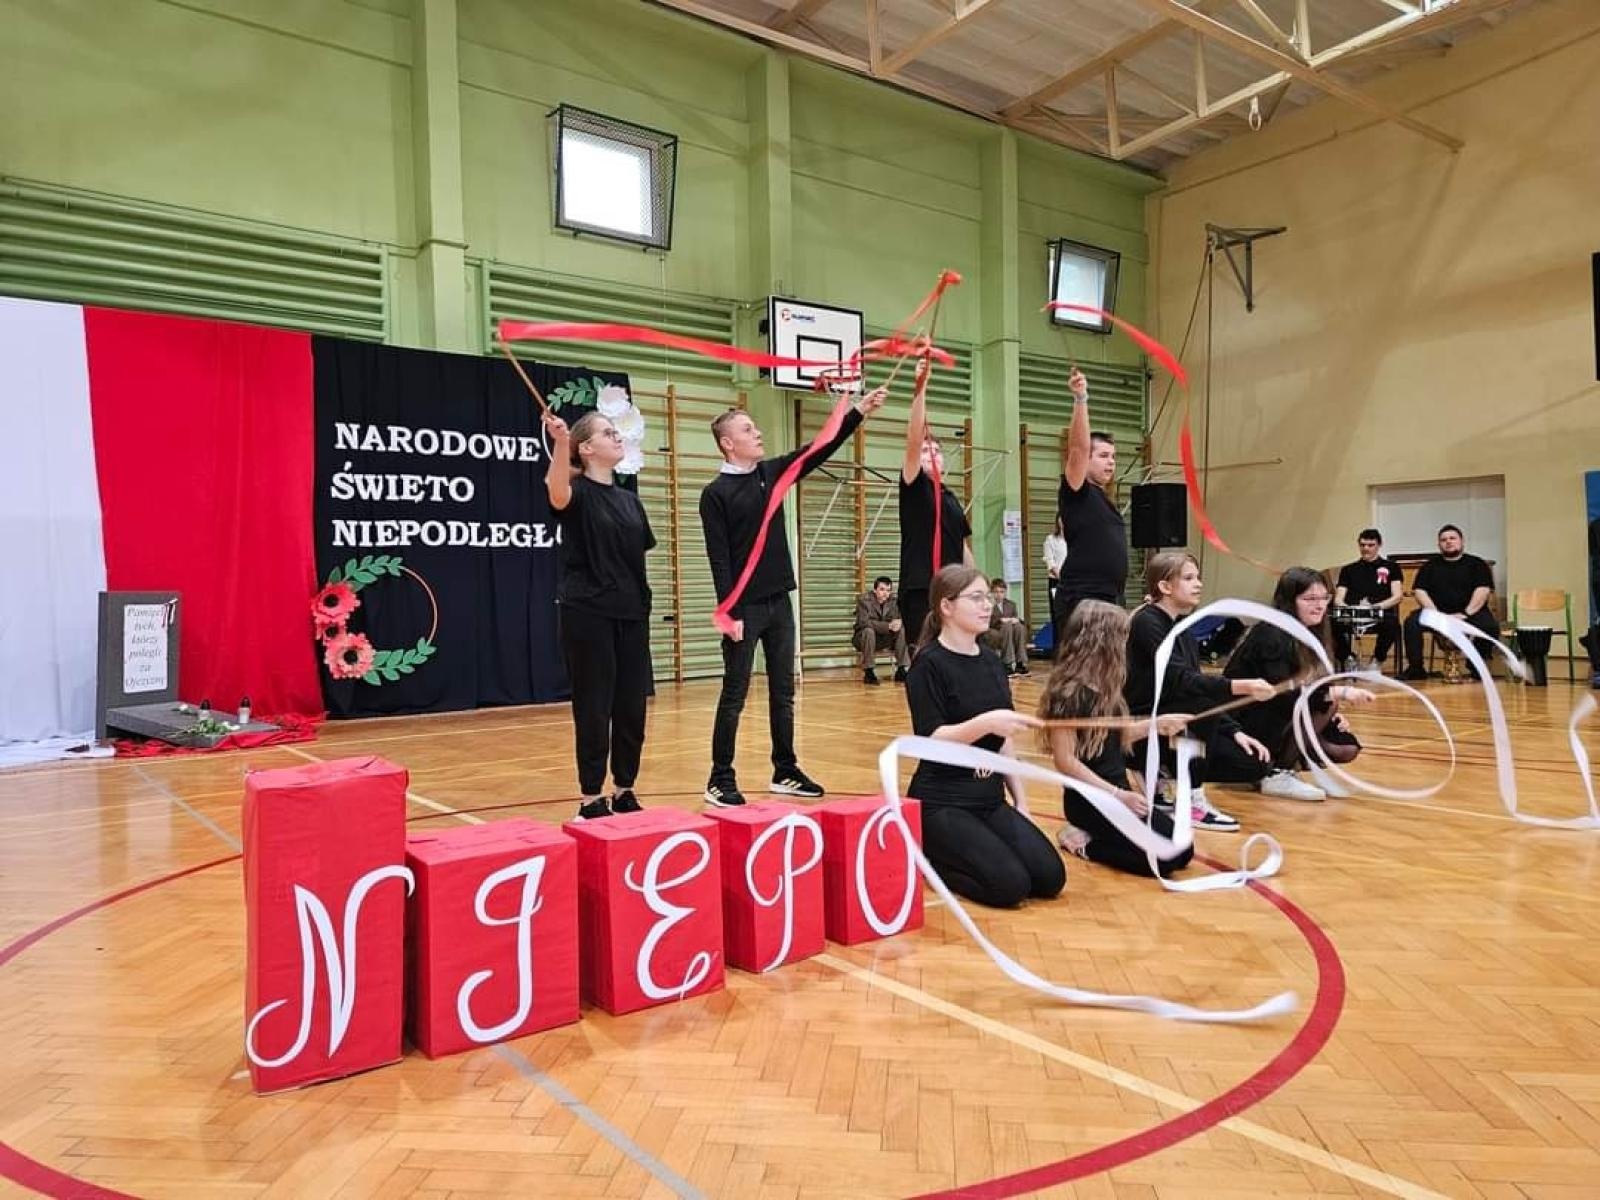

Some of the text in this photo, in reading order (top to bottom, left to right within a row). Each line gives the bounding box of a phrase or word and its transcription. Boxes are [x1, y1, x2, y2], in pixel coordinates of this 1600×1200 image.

[335, 422, 541, 462] NARODOWE
[330, 460, 475, 503] ŚWIĘTO
[331, 518, 562, 548] NIEPODLEGŁ
